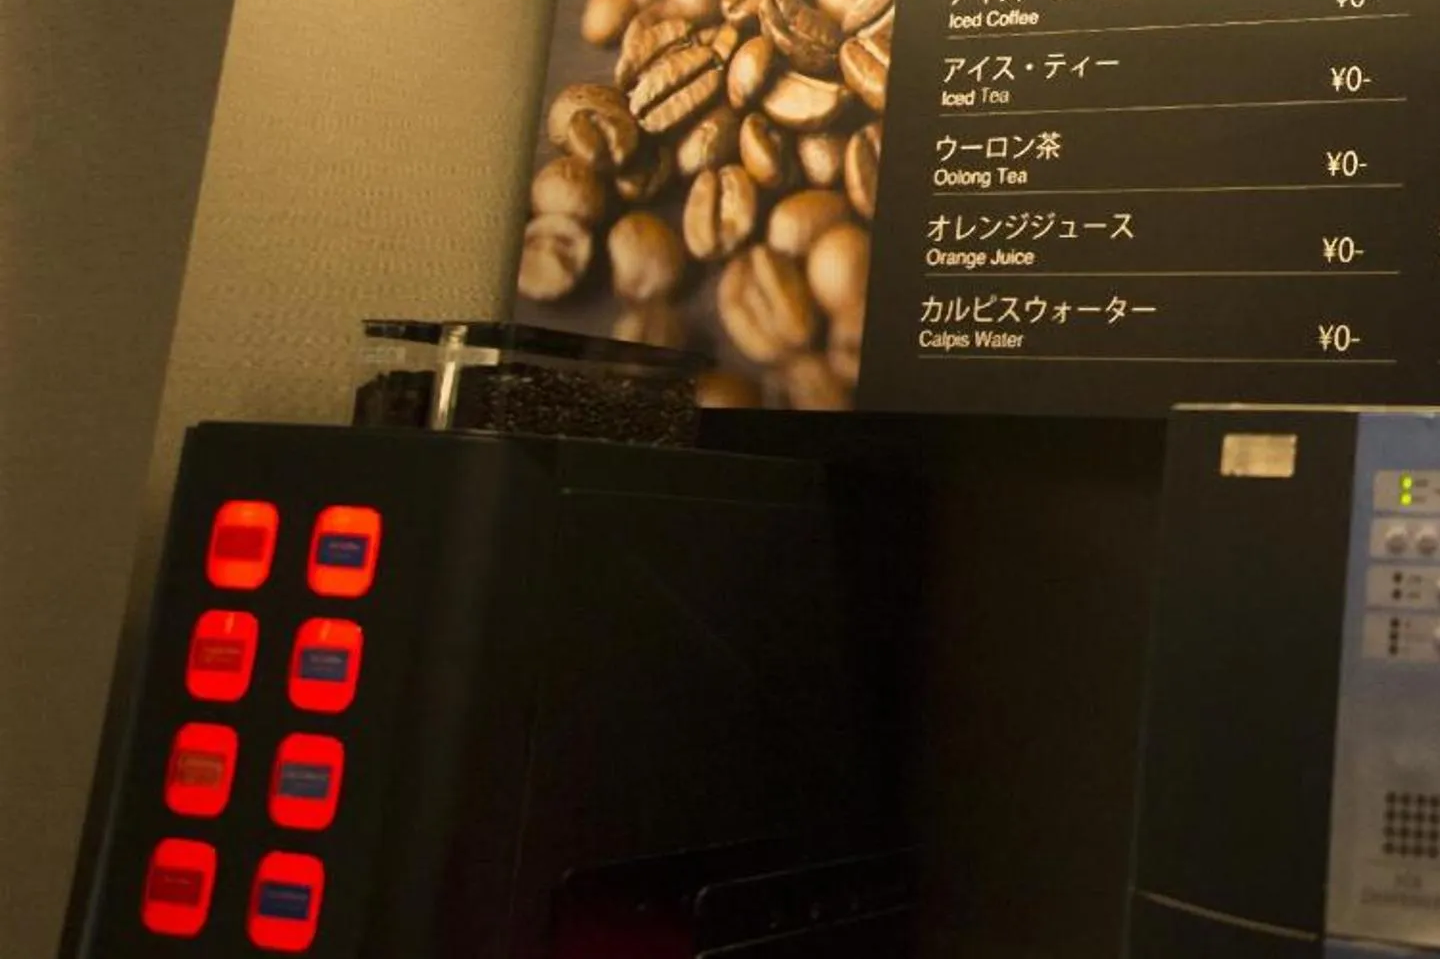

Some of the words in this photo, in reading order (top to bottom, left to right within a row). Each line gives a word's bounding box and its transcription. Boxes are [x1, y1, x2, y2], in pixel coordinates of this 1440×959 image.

[949, 11, 983, 29] Iced
[985, 8, 1040, 27] Coffee
[941, 89, 976, 106] Iced
[981, 86, 1010, 104] Tea
[936, 131, 1061, 162] ウーロン茶
[933, 167, 992, 188] Oolong
[996, 167, 1028, 185] Tea
[927, 212, 1134, 242] オレンジジュース
[926, 247, 987, 271] Orange
[990, 248, 1035, 266] Juice
[920, 295, 1157, 324] カルピスウォーター
[918, 329, 971, 352] Calpis
[974, 330, 1024, 349] Water
